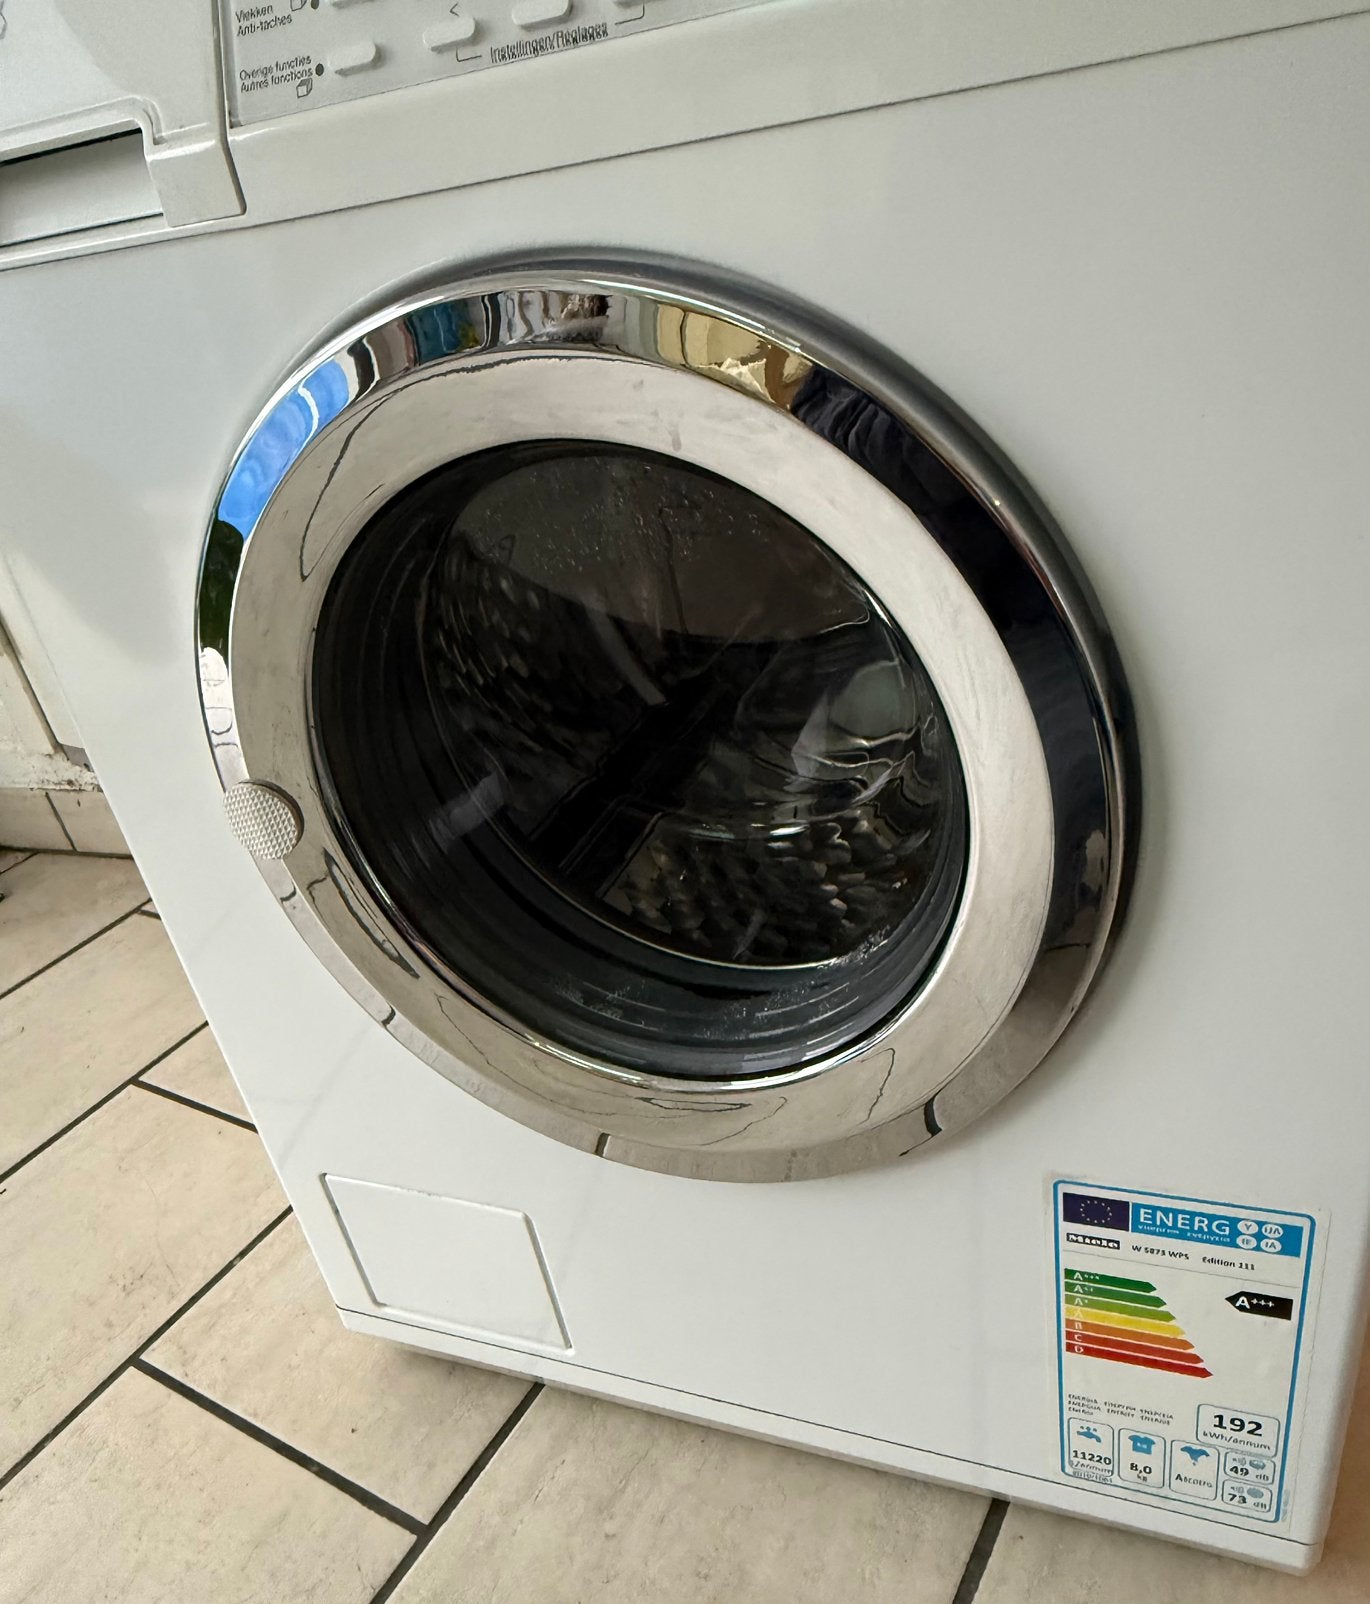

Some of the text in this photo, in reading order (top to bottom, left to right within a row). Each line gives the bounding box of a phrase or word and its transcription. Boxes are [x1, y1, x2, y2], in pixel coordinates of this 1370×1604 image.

[1139, 1208, 1230, 1235] ENERG
[1201, 1256, 1235, 1268] Edition
[1235, 1296, 1275, 1309] A+++
[1213, 1414, 1263, 1437] 192
[1072, 1450, 1112, 1465] 11220
[1129, 1462, 1152, 1476] 8,0
[1230, 1466, 1249, 1477] 49
[1228, 1493, 1247, 1504] 73
